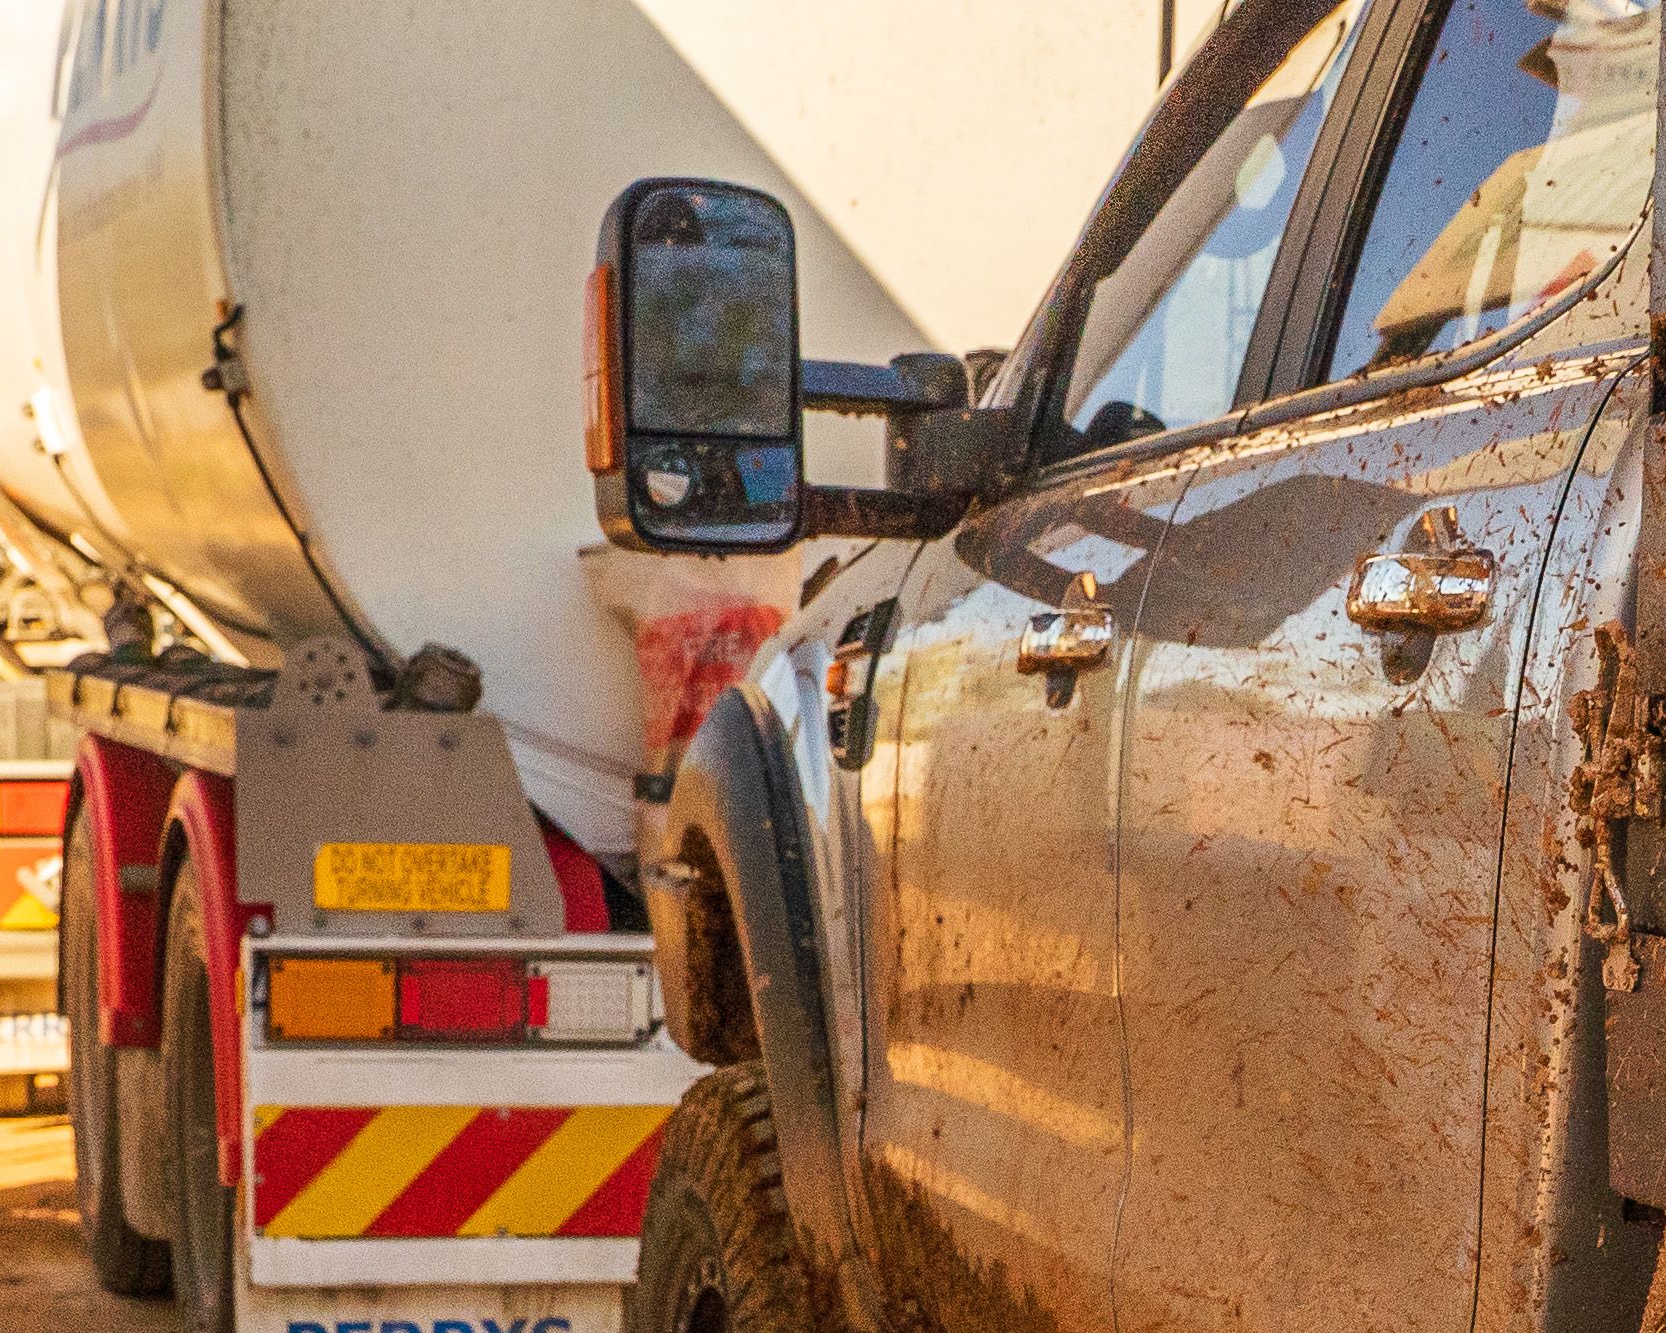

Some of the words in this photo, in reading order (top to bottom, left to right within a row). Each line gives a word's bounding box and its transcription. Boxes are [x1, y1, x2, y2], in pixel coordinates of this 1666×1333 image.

[331, 848, 357, 873] DO
[362, 848, 395, 873] NOT
[402, 848, 492, 875] OVERTAKE
[336, 876, 409, 904] TURNING
[417, 877, 491, 905] VEHICLE
